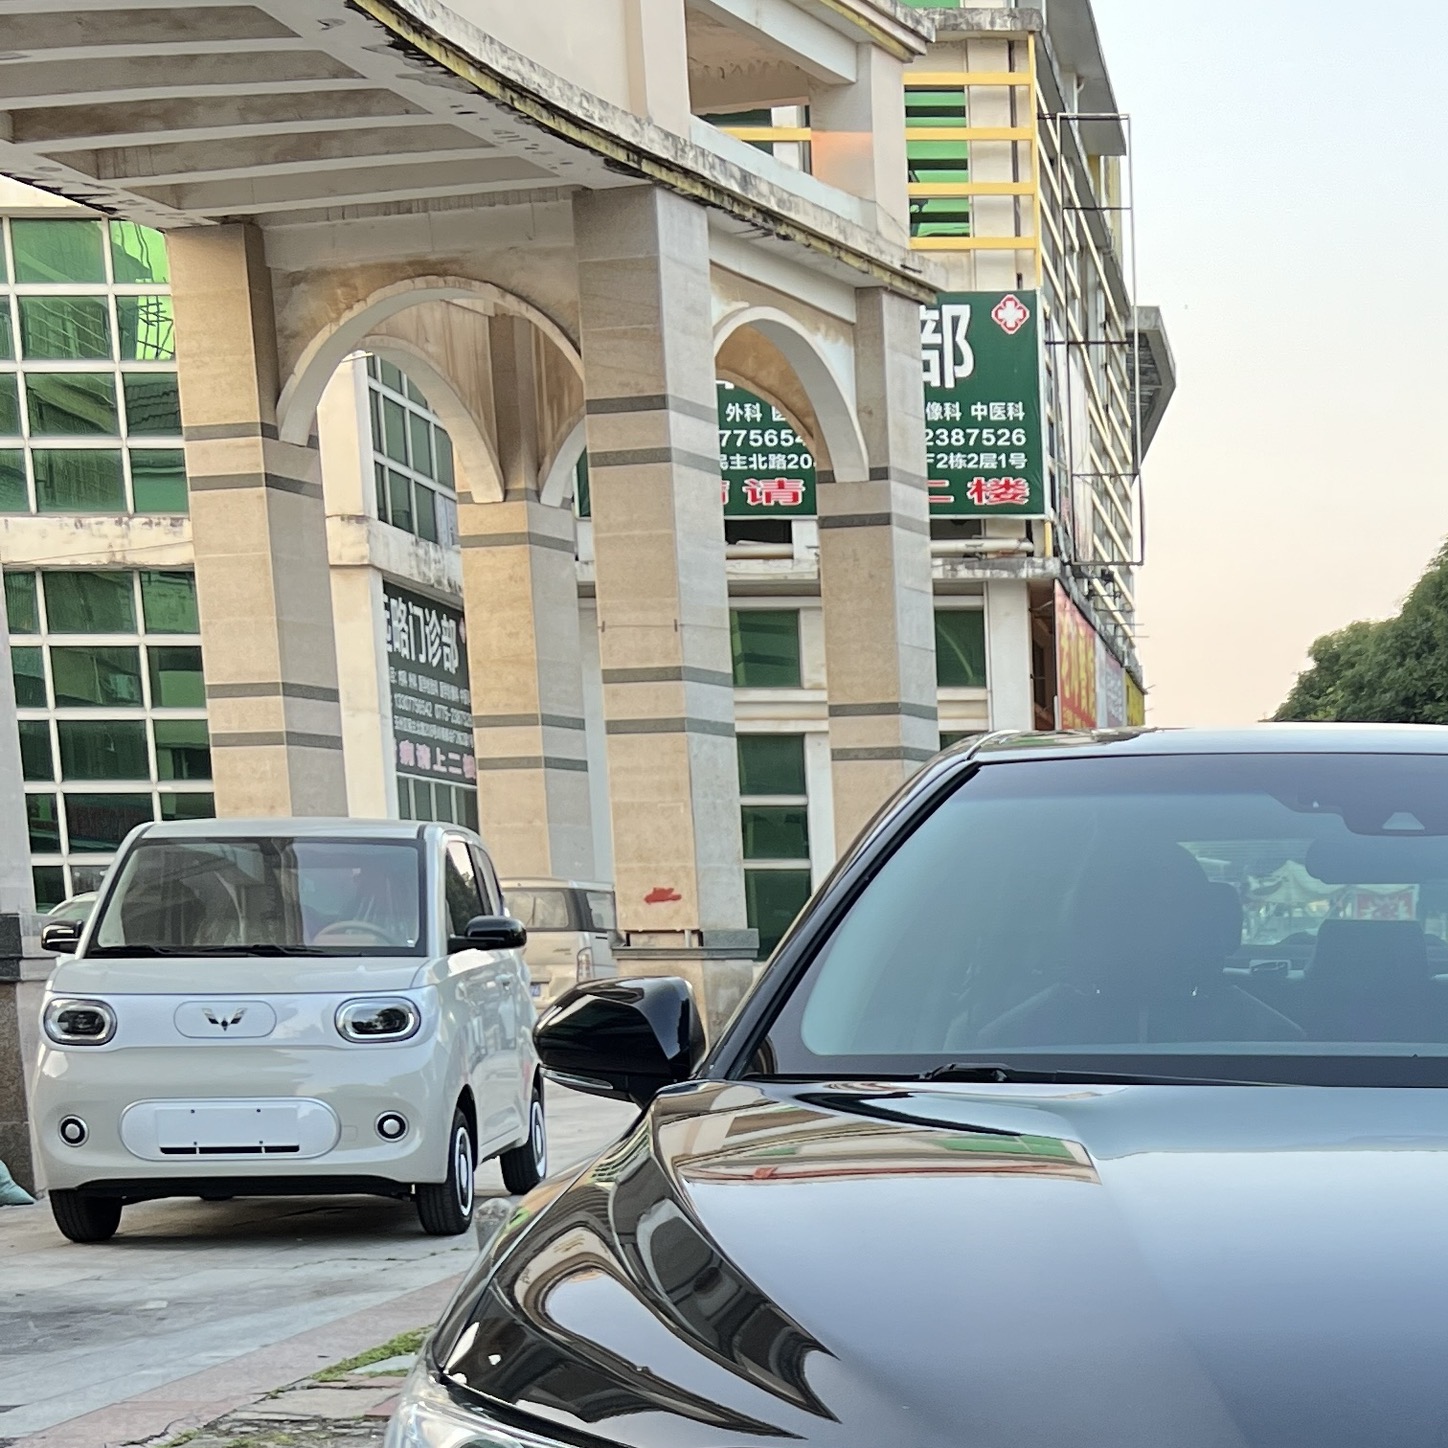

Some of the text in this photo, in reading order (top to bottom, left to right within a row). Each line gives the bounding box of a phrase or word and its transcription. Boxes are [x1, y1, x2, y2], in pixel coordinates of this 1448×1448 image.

[919, 304, 975, 389] 部
[725, 402, 763, 423] 外科
[971, 401, 1026, 422] 中医科
[925, 428, 1027, 447] 2387526
[720, 453, 817, 471] 主北路20
[722, 477, 806, 506] 请
